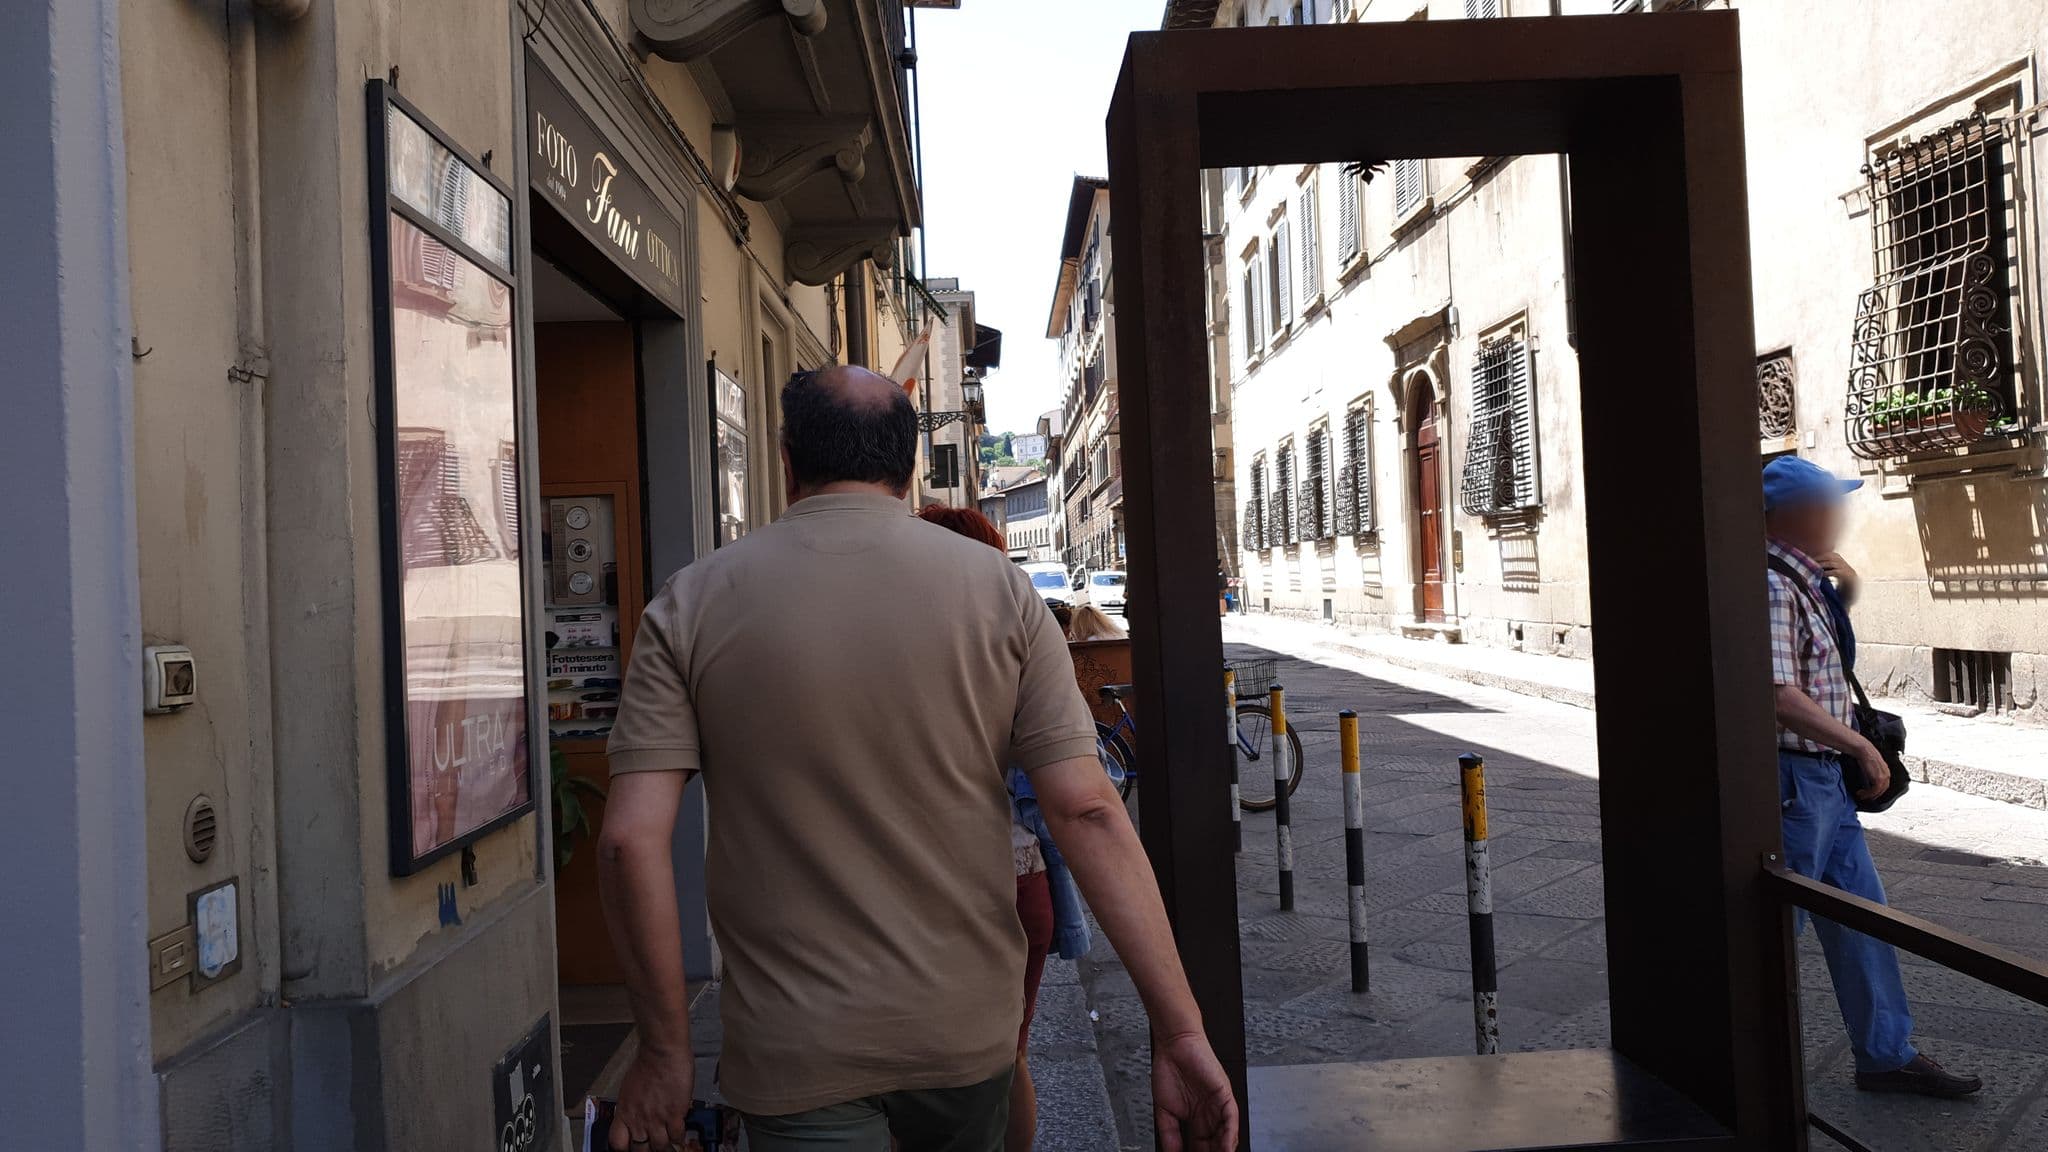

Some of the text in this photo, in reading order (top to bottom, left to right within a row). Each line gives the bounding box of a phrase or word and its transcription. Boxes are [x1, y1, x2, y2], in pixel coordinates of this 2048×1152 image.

[536, 111, 679, 287] FOTO Fani OTTICA
[552, 654, 614, 663] Fototessera
[552, 663, 607, 674] in 1 minuto
[433, 709, 505, 772] ULTRA
[434, 754, 506, 798] LIED
